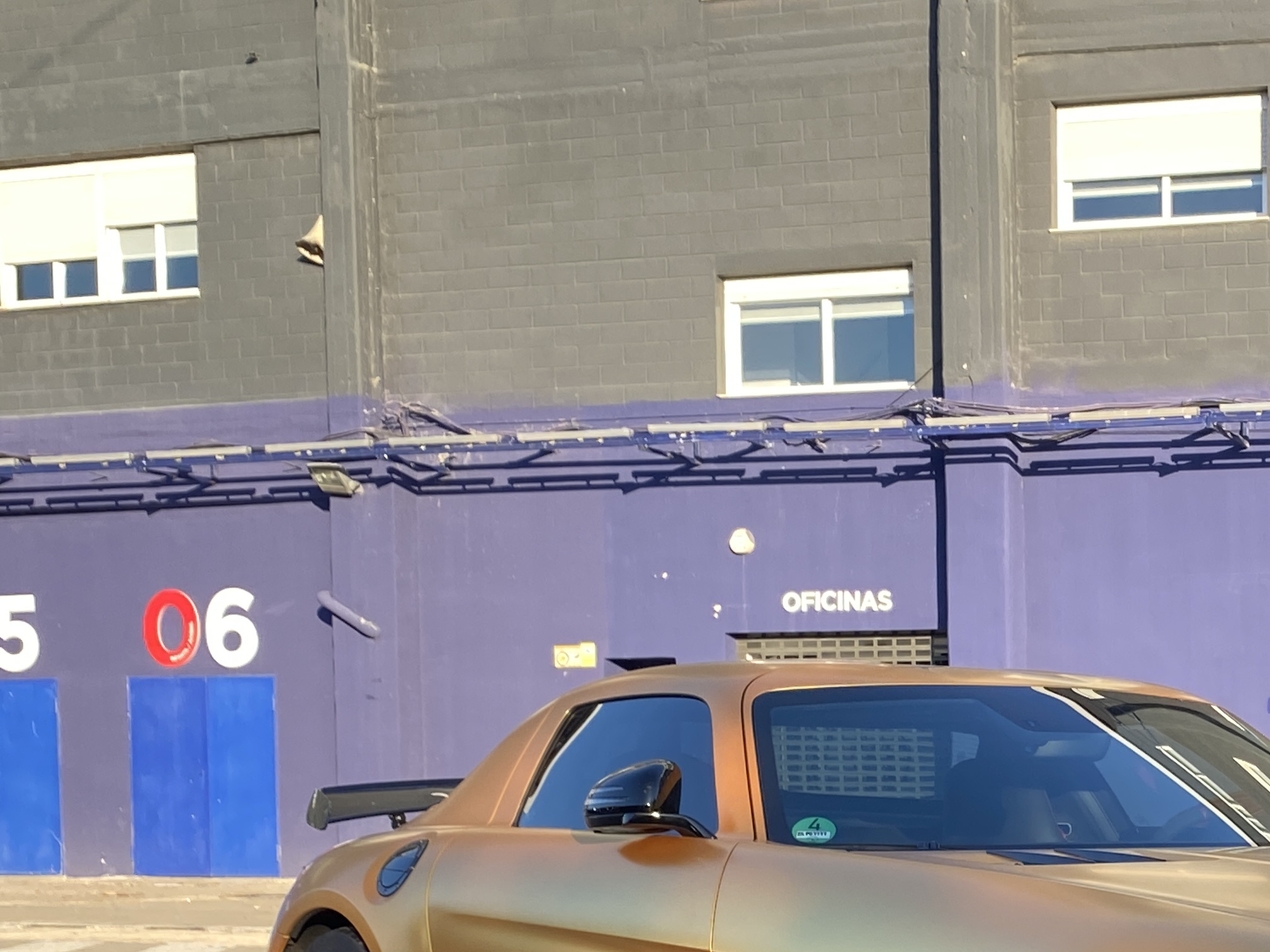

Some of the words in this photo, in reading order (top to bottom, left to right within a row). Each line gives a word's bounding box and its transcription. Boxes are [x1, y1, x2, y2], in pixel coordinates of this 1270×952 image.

[781, 588, 894, 613] OFICINAS
[143, 586, 260, 669] 06
[807, 817, 821, 831] 4
